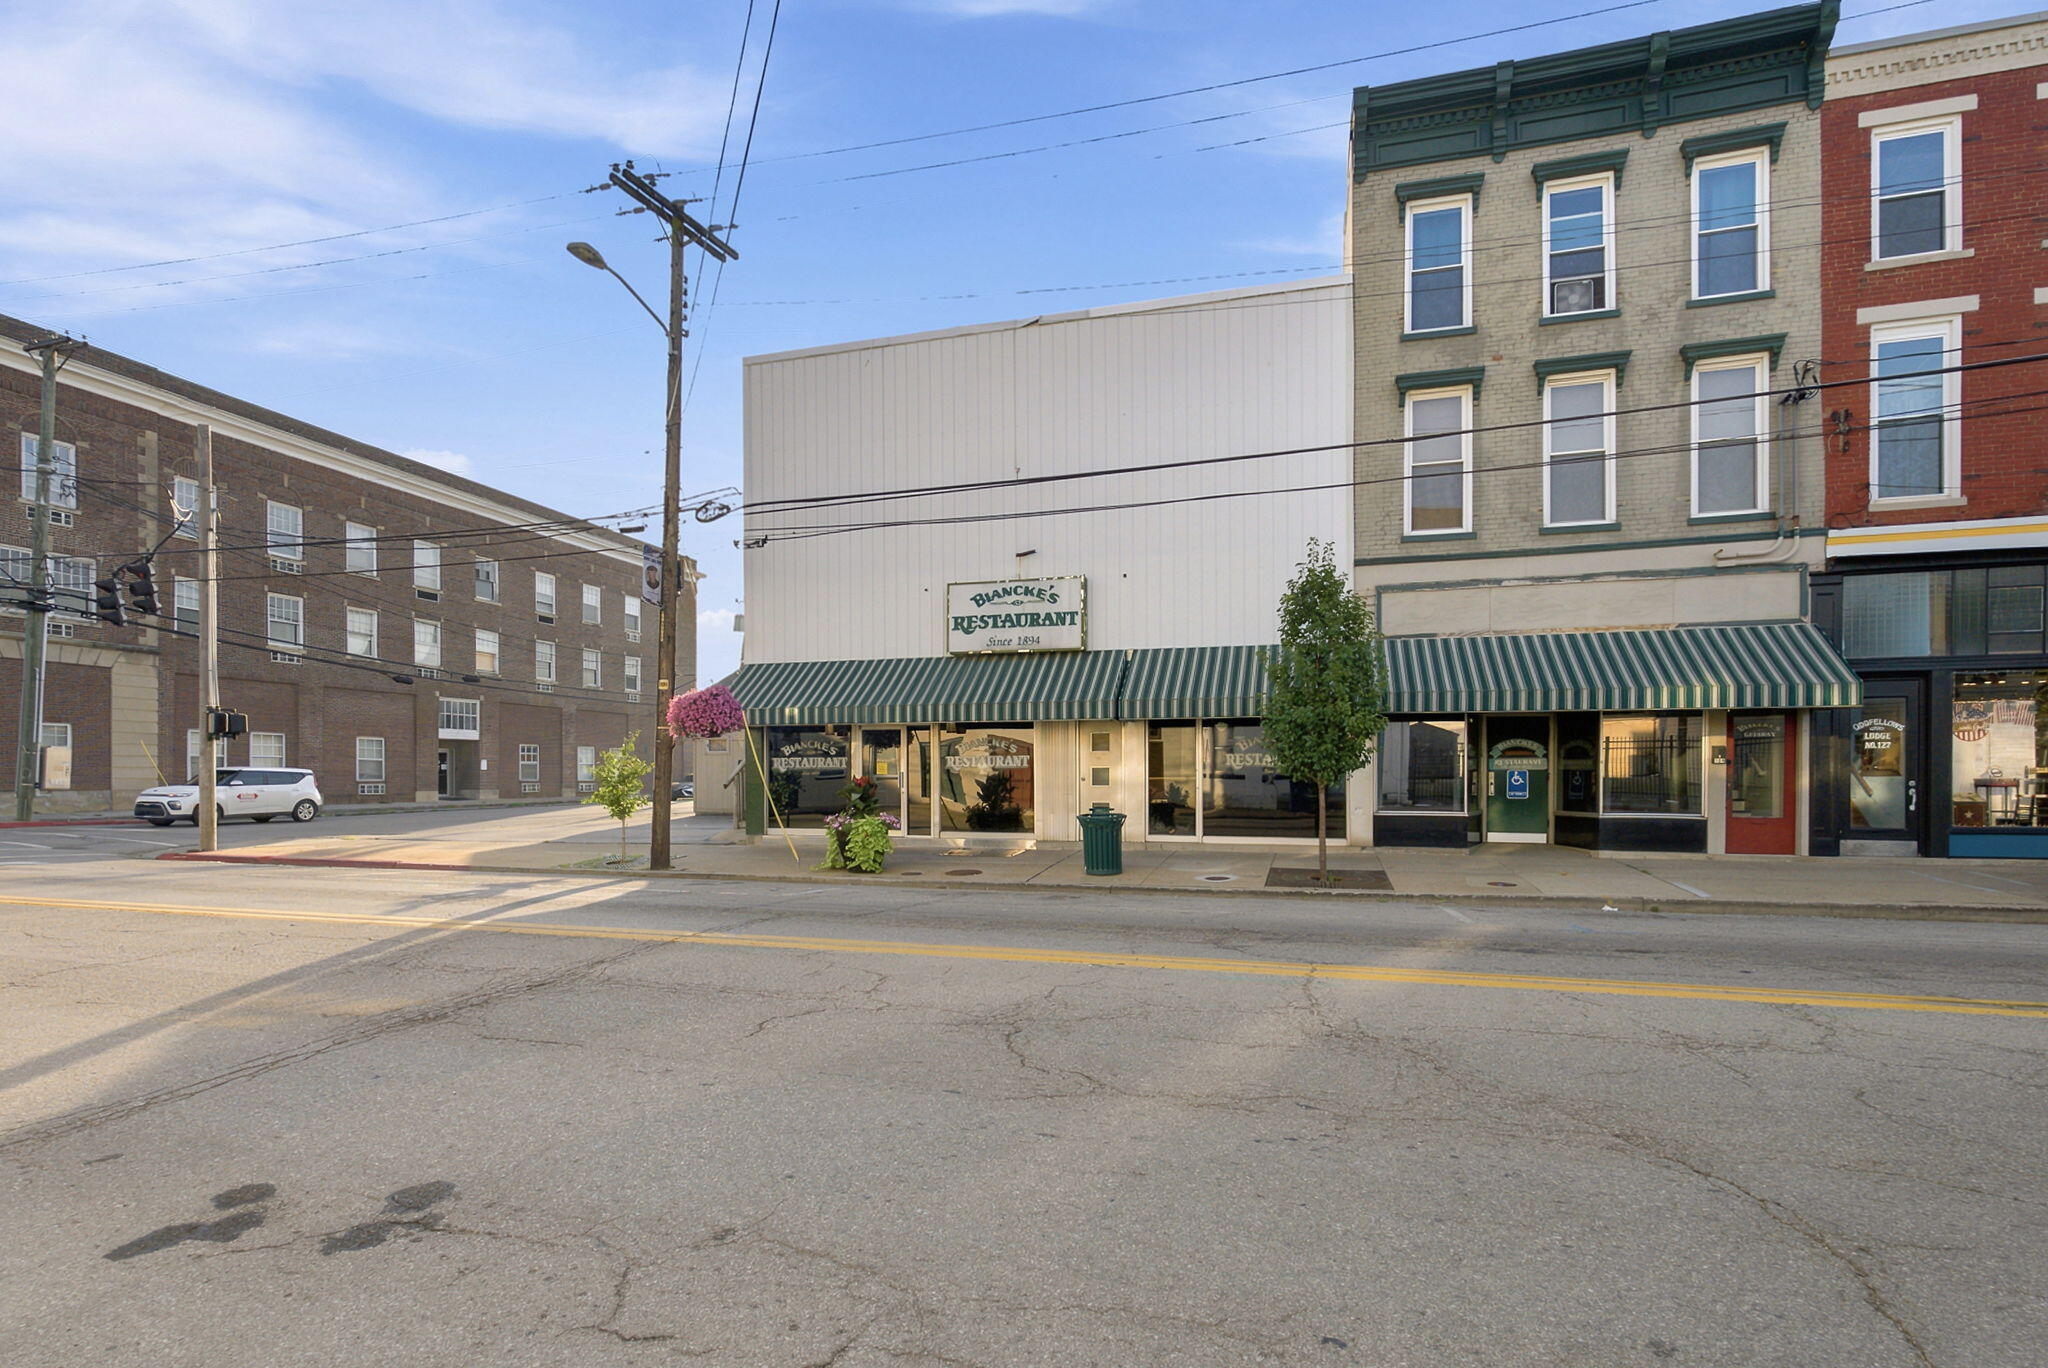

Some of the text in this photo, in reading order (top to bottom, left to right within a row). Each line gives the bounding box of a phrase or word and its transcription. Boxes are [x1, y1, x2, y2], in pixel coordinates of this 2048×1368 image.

[970, 585, 1060, 608] BIANCKE'S
[951, 611, 1079, 635] RESTAURANT
[986, 635, 1041, 647] Since 1894
[1852, 718, 1905, 731] ODDFELLOWS
[1863, 732, 1892, 740] LODGE
[780, 740, 839, 757] BIANCKE'S
[771, 756, 848, 774] RESTAURANT
[945, 755, 1030, 774] RESTAURANT
